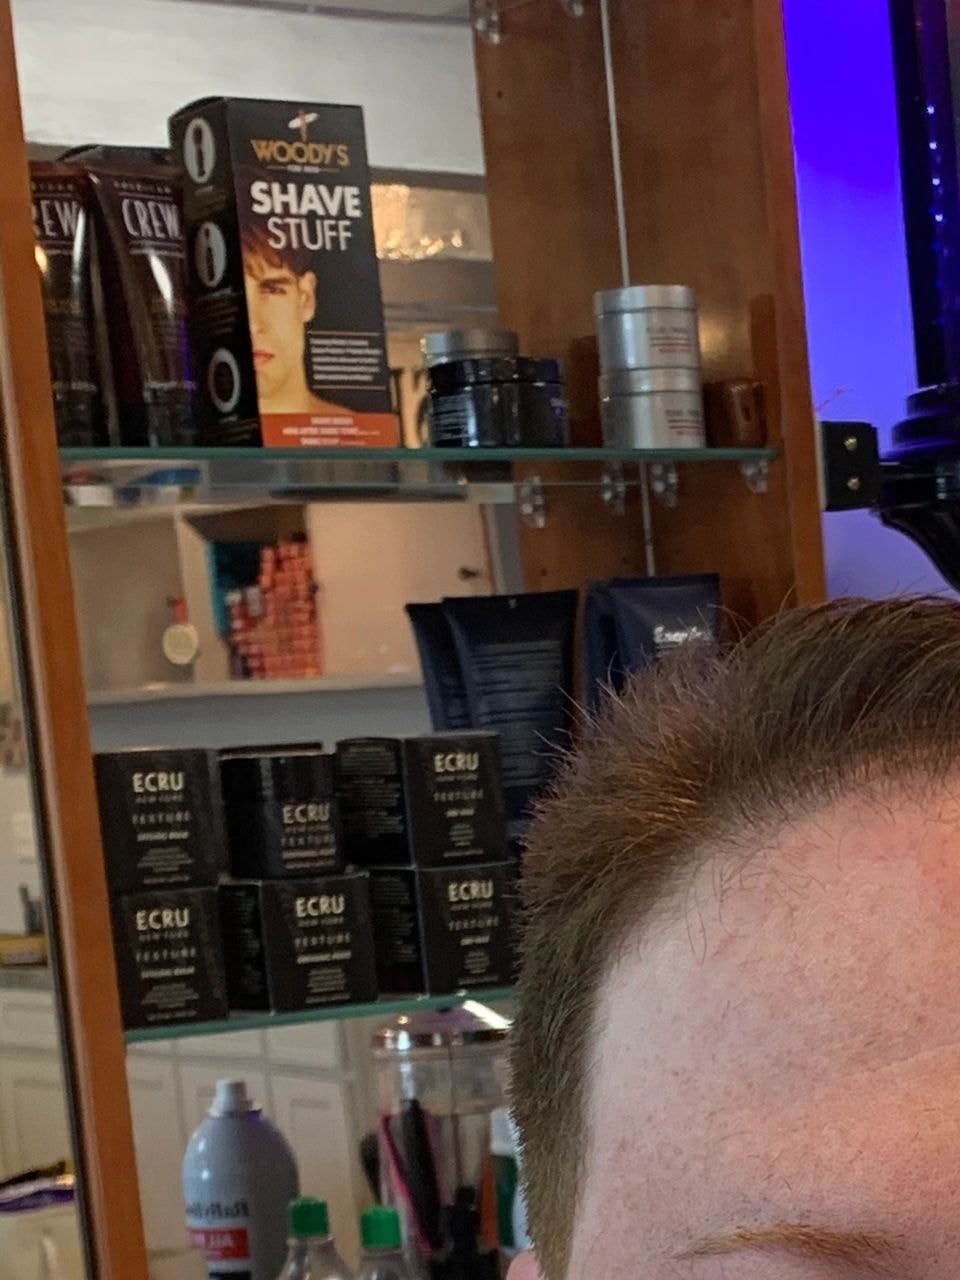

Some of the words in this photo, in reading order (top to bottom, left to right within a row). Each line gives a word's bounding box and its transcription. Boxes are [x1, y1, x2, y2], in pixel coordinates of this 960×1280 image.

[251, 139, 350, 167] WOODY'S
[250, 181, 362, 218] SHAVE
[121, 198, 181, 239] CREW
[267, 216, 352, 251] STUFF
[433, 752, 480, 773] ECRU
[132, 772, 184, 793] ECRU
[282, 803, 331, 824] ECRU
[448, 880, 494, 902] ECRU
[295, 894, 345, 918] ECRU
[136, 908, 190, 931] ECRU
